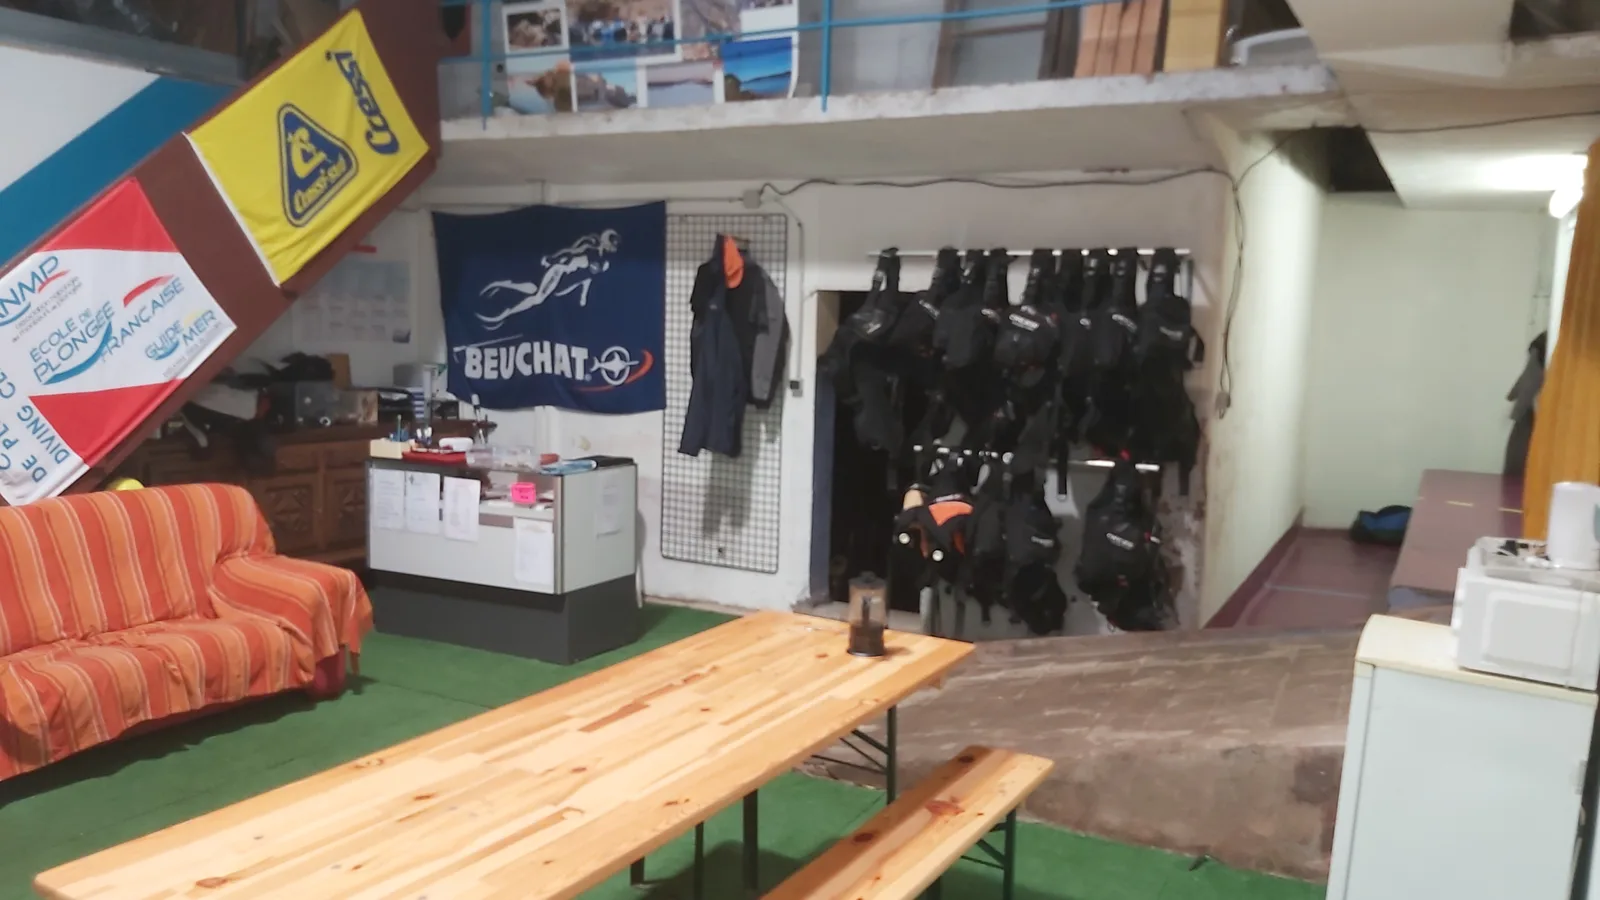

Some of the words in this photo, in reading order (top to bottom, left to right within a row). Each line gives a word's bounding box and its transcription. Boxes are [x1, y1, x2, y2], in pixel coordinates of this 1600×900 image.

[325, 51, 400, 155] Cressi
[0, 256, 59, 318] NMP
[145, 320, 184, 359] GUIDE
[182, 309, 217, 346] MER
[464, 340, 589, 380] BEUCHAT
[17, 404, 70, 464] DIVING
[21, 454, 48, 483] DE
